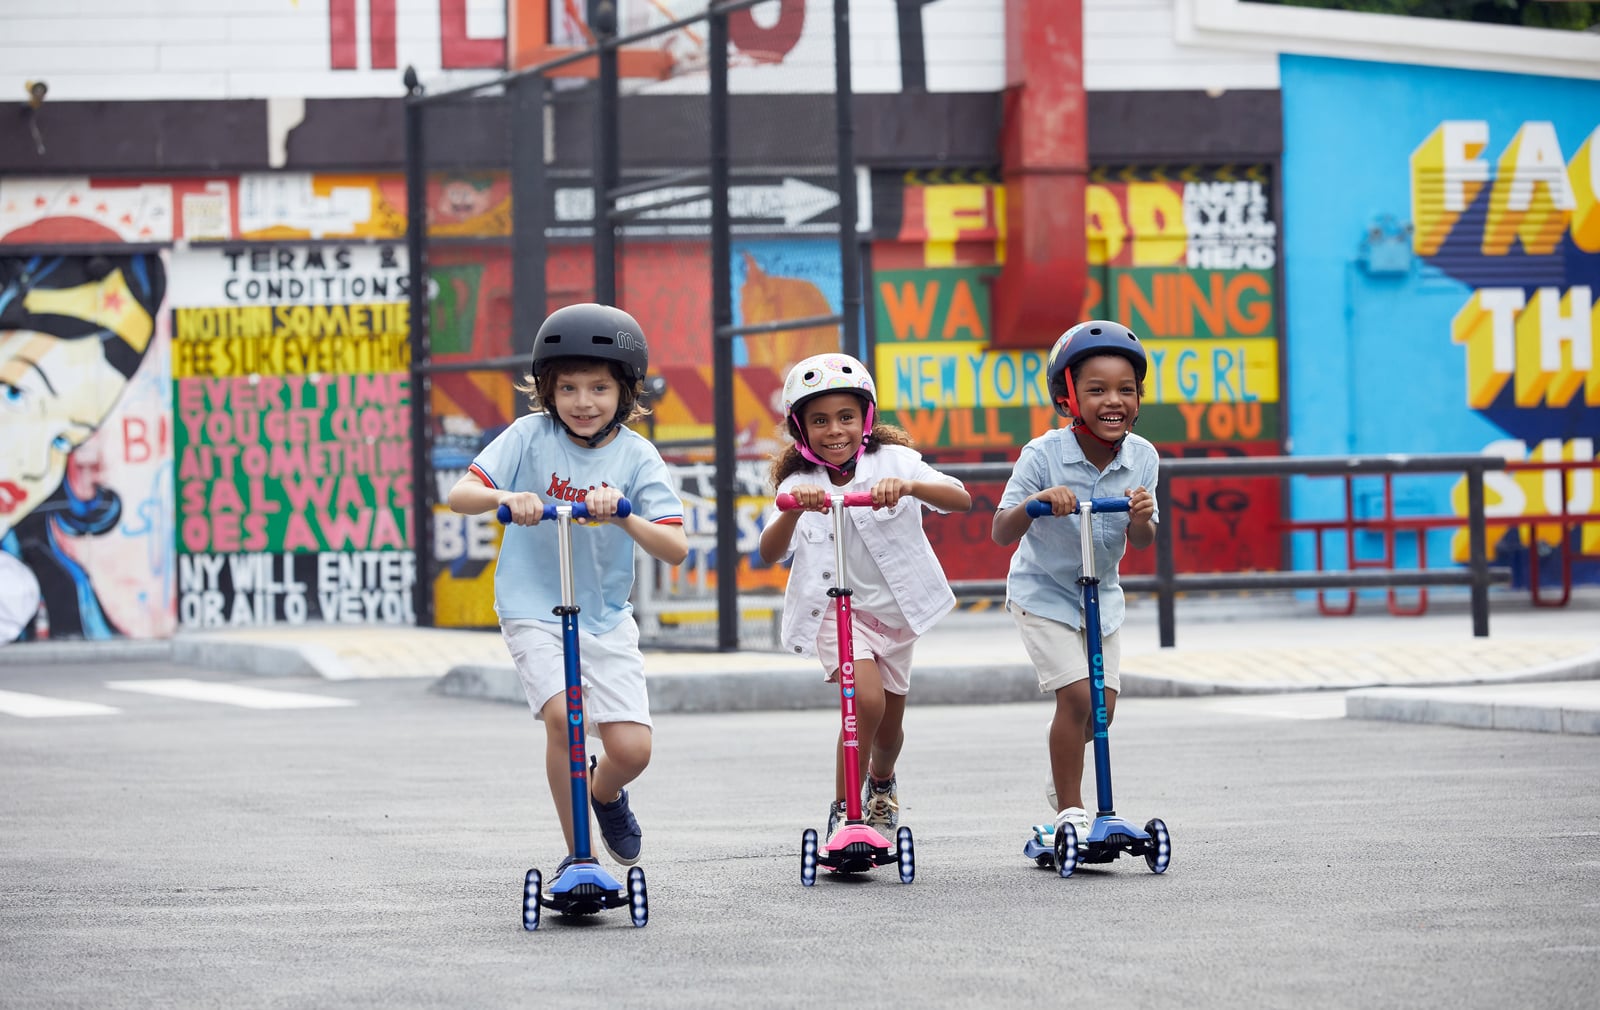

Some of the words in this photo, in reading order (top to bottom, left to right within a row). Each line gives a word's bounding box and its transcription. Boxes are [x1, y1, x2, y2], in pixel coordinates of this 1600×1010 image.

[224, 250, 352, 272] TERMS
[224, 276, 411, 300] CONDITIONS
[1179, 404, 1264, 441] YOU
